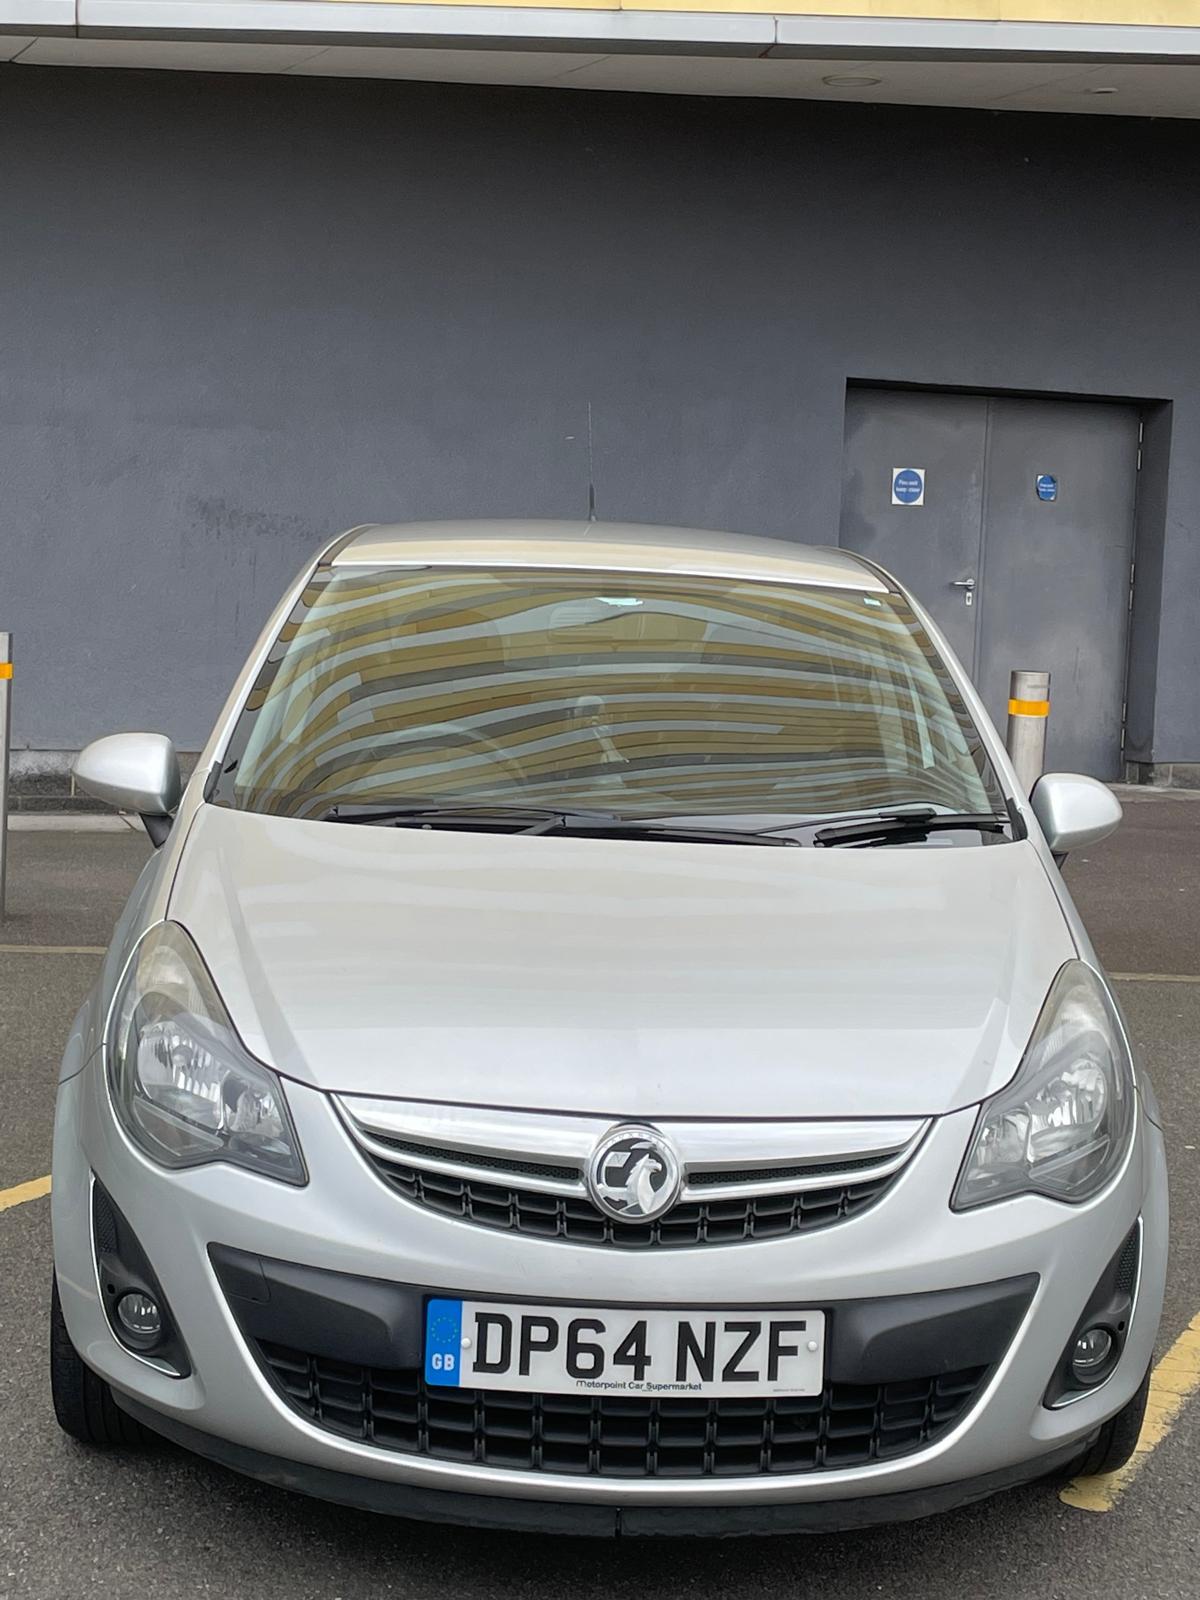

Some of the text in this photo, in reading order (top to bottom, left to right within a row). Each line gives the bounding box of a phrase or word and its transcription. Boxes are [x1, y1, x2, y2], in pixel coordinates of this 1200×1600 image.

[473, 1312, 807, 1382] DP64 NZF
[432, 1353, 454, 1370] GB
[576, 1380, 702, 1392] Motorpoint Car Supermarket
